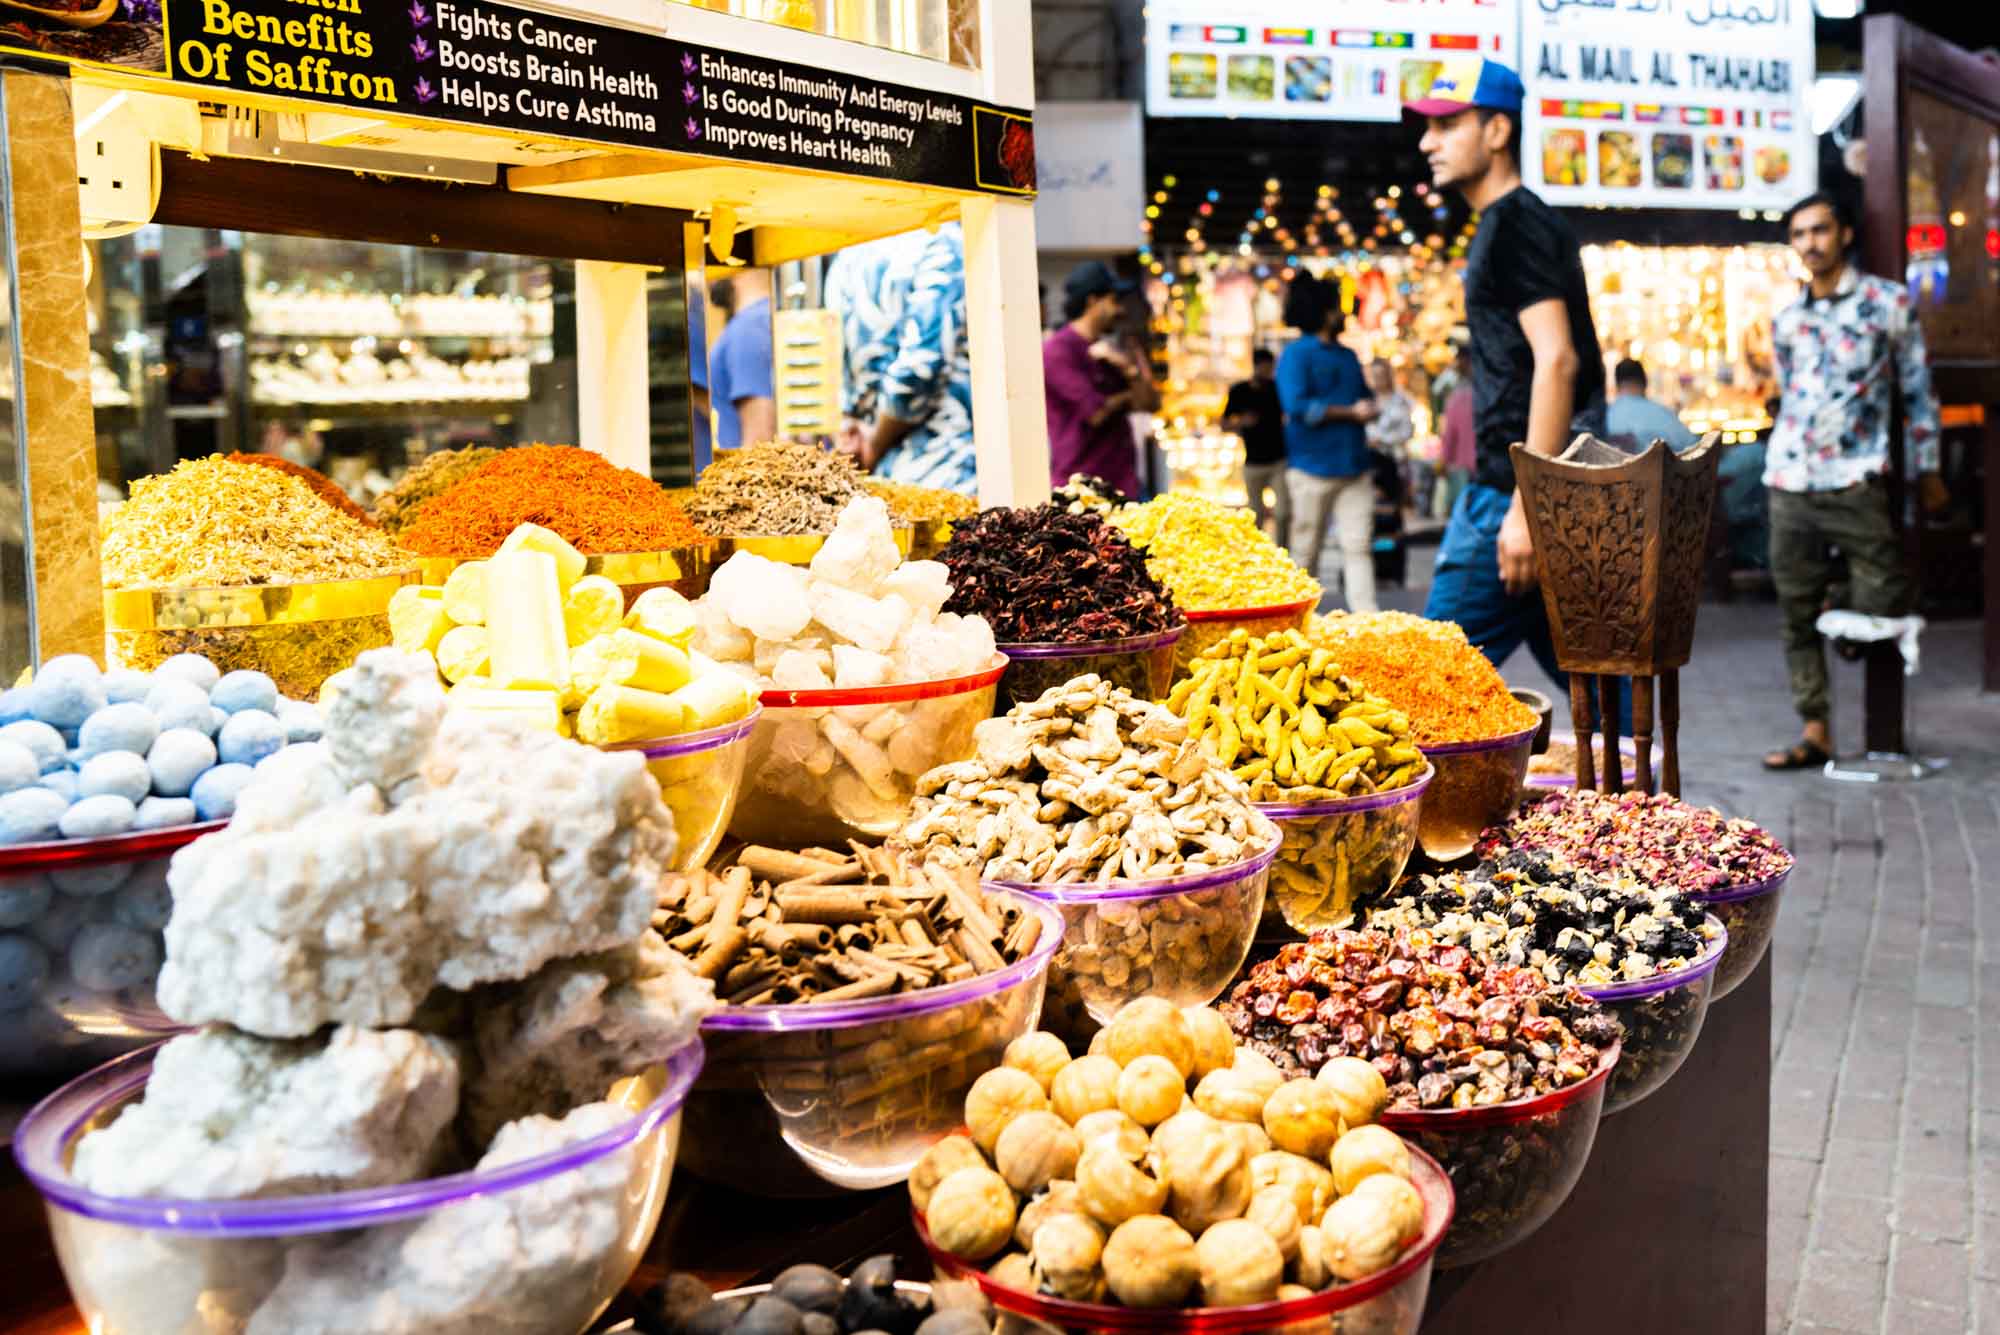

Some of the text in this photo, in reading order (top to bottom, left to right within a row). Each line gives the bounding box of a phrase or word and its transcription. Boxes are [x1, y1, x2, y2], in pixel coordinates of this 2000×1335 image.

[203, 0, 373, 58] Benefits
[436, 2, 597, 56] Fights Cancer
[179, 39, 398, 104] Of Saffron
[439, 40, 658, 100] Boosts Brain Health
[701, 53, 963, 126] Enhances Immunity And Energy Levels
[1538, 42, 1569, 80] AL
[1651, 52, 1678, 87] AL
[441, 77, 656, 132] Helps Cure Asthma
[703, 86, 914, 148] Is Good During Pregnancy
[704, 118, 892, 168] Improves Heart Health
